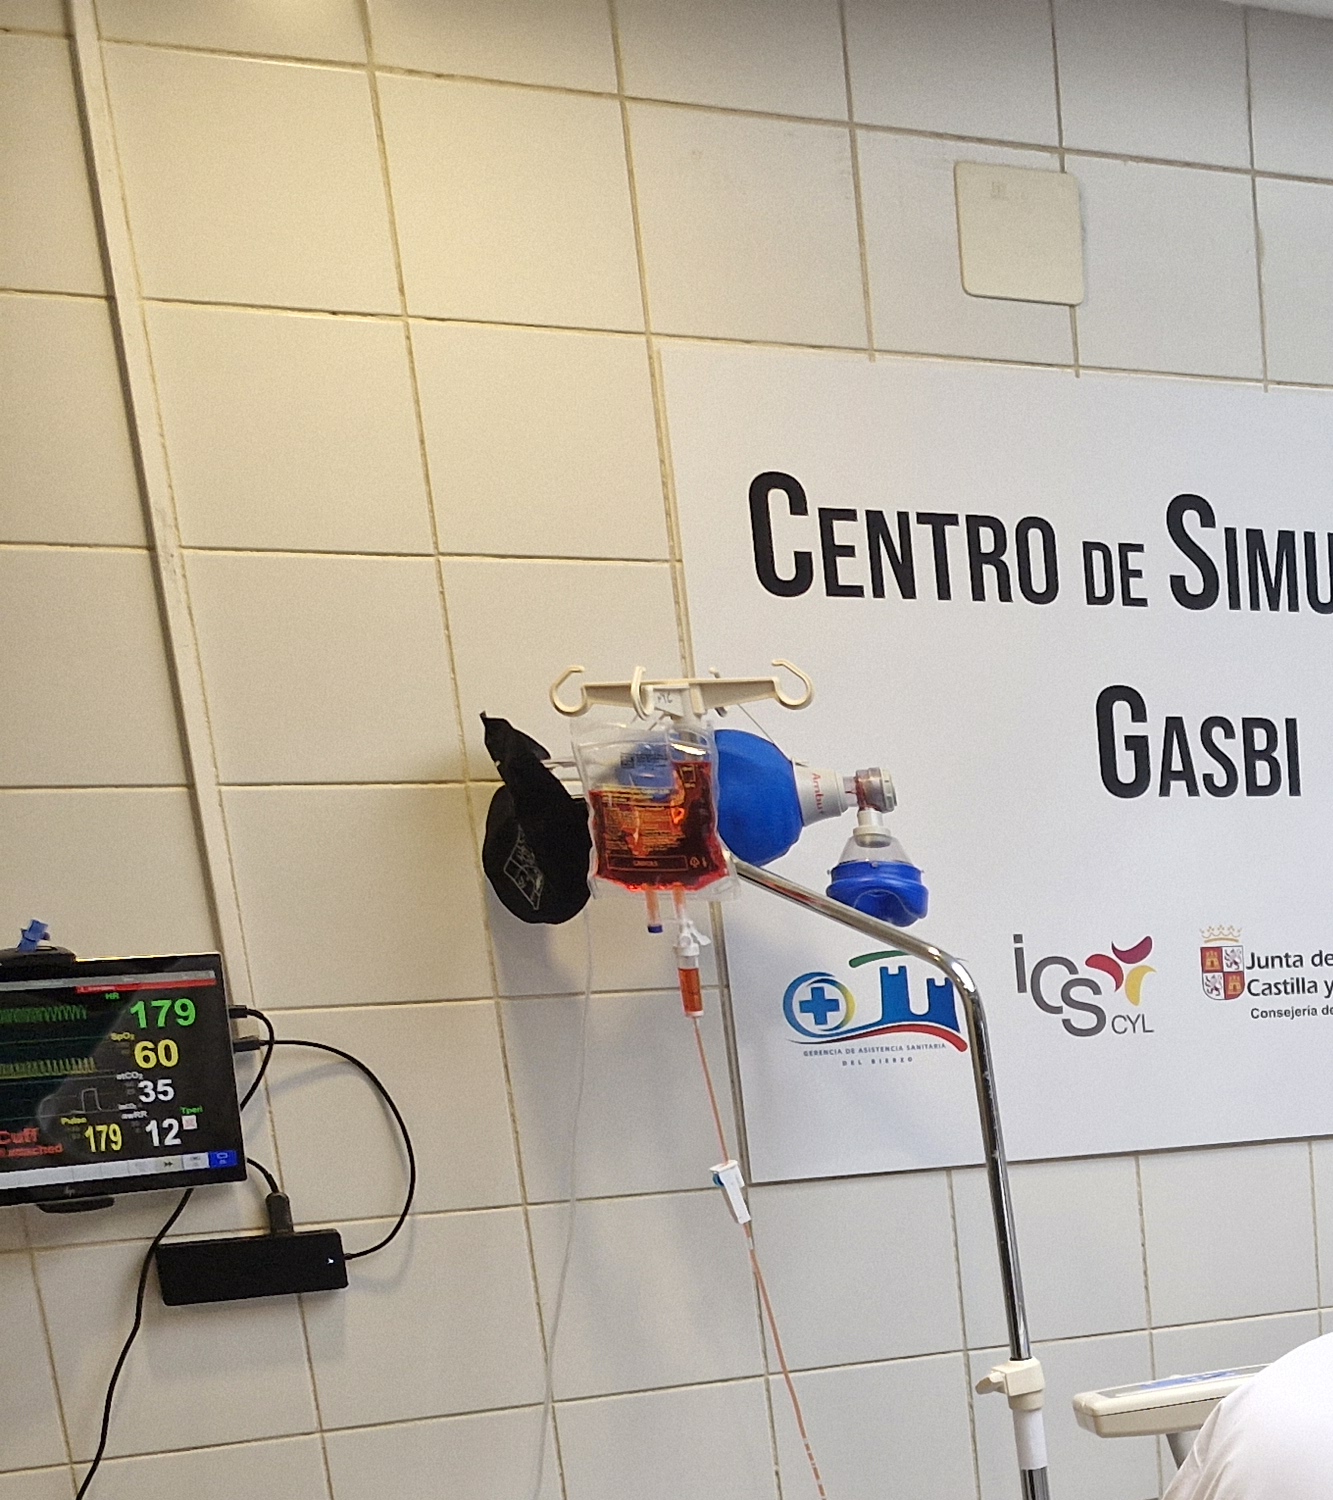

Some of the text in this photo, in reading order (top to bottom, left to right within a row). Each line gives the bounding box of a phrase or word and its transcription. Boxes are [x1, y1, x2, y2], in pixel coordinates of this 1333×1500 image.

[1245, 952, 1304, 971] Junta
[1246, 977, 1319, 998] Castilla
[130, 998, 197, 1029] 179
[1111, 1013, 1155, 1036] CYL
[1250, 1004, 1319, 1021] Consejería
[134, 1039, 179, 1069] 60
[138, 1079, 175, 1103] 35
[84, 1124, 122, 1153] 179
[146, 1118, 182, 1147] 12
